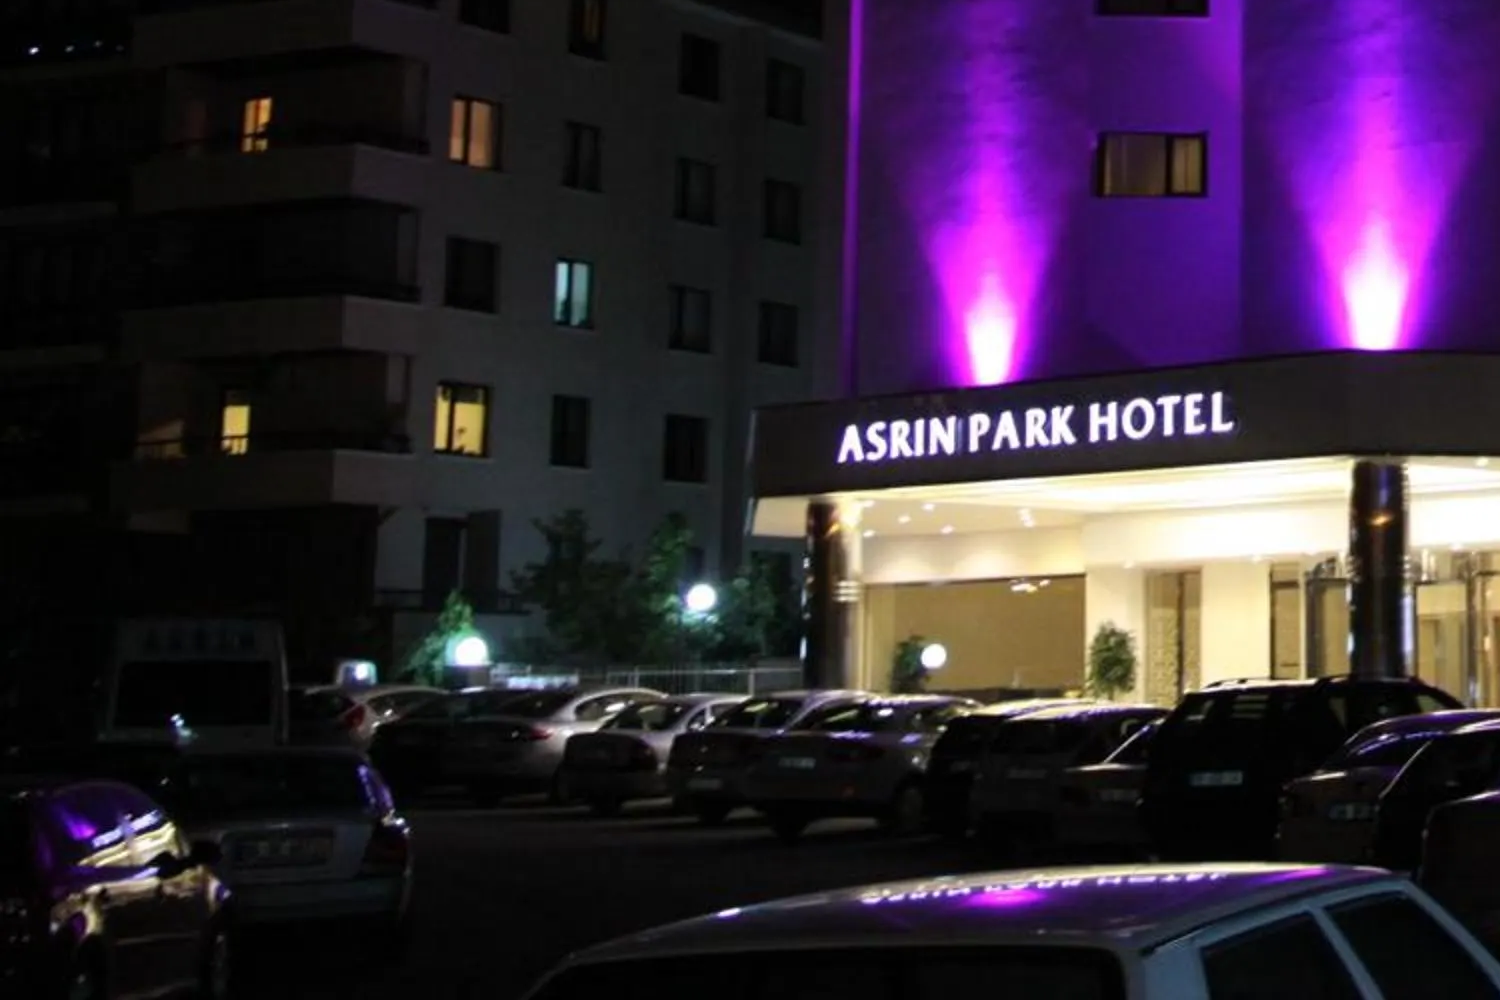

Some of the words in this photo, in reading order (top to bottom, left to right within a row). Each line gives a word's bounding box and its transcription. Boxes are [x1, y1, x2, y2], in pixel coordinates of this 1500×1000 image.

[836, 415, 958, 464] ASRIN
[967, 404, 1077, 453] PARK
[1087, 390, 1236, 444] HOTEL
